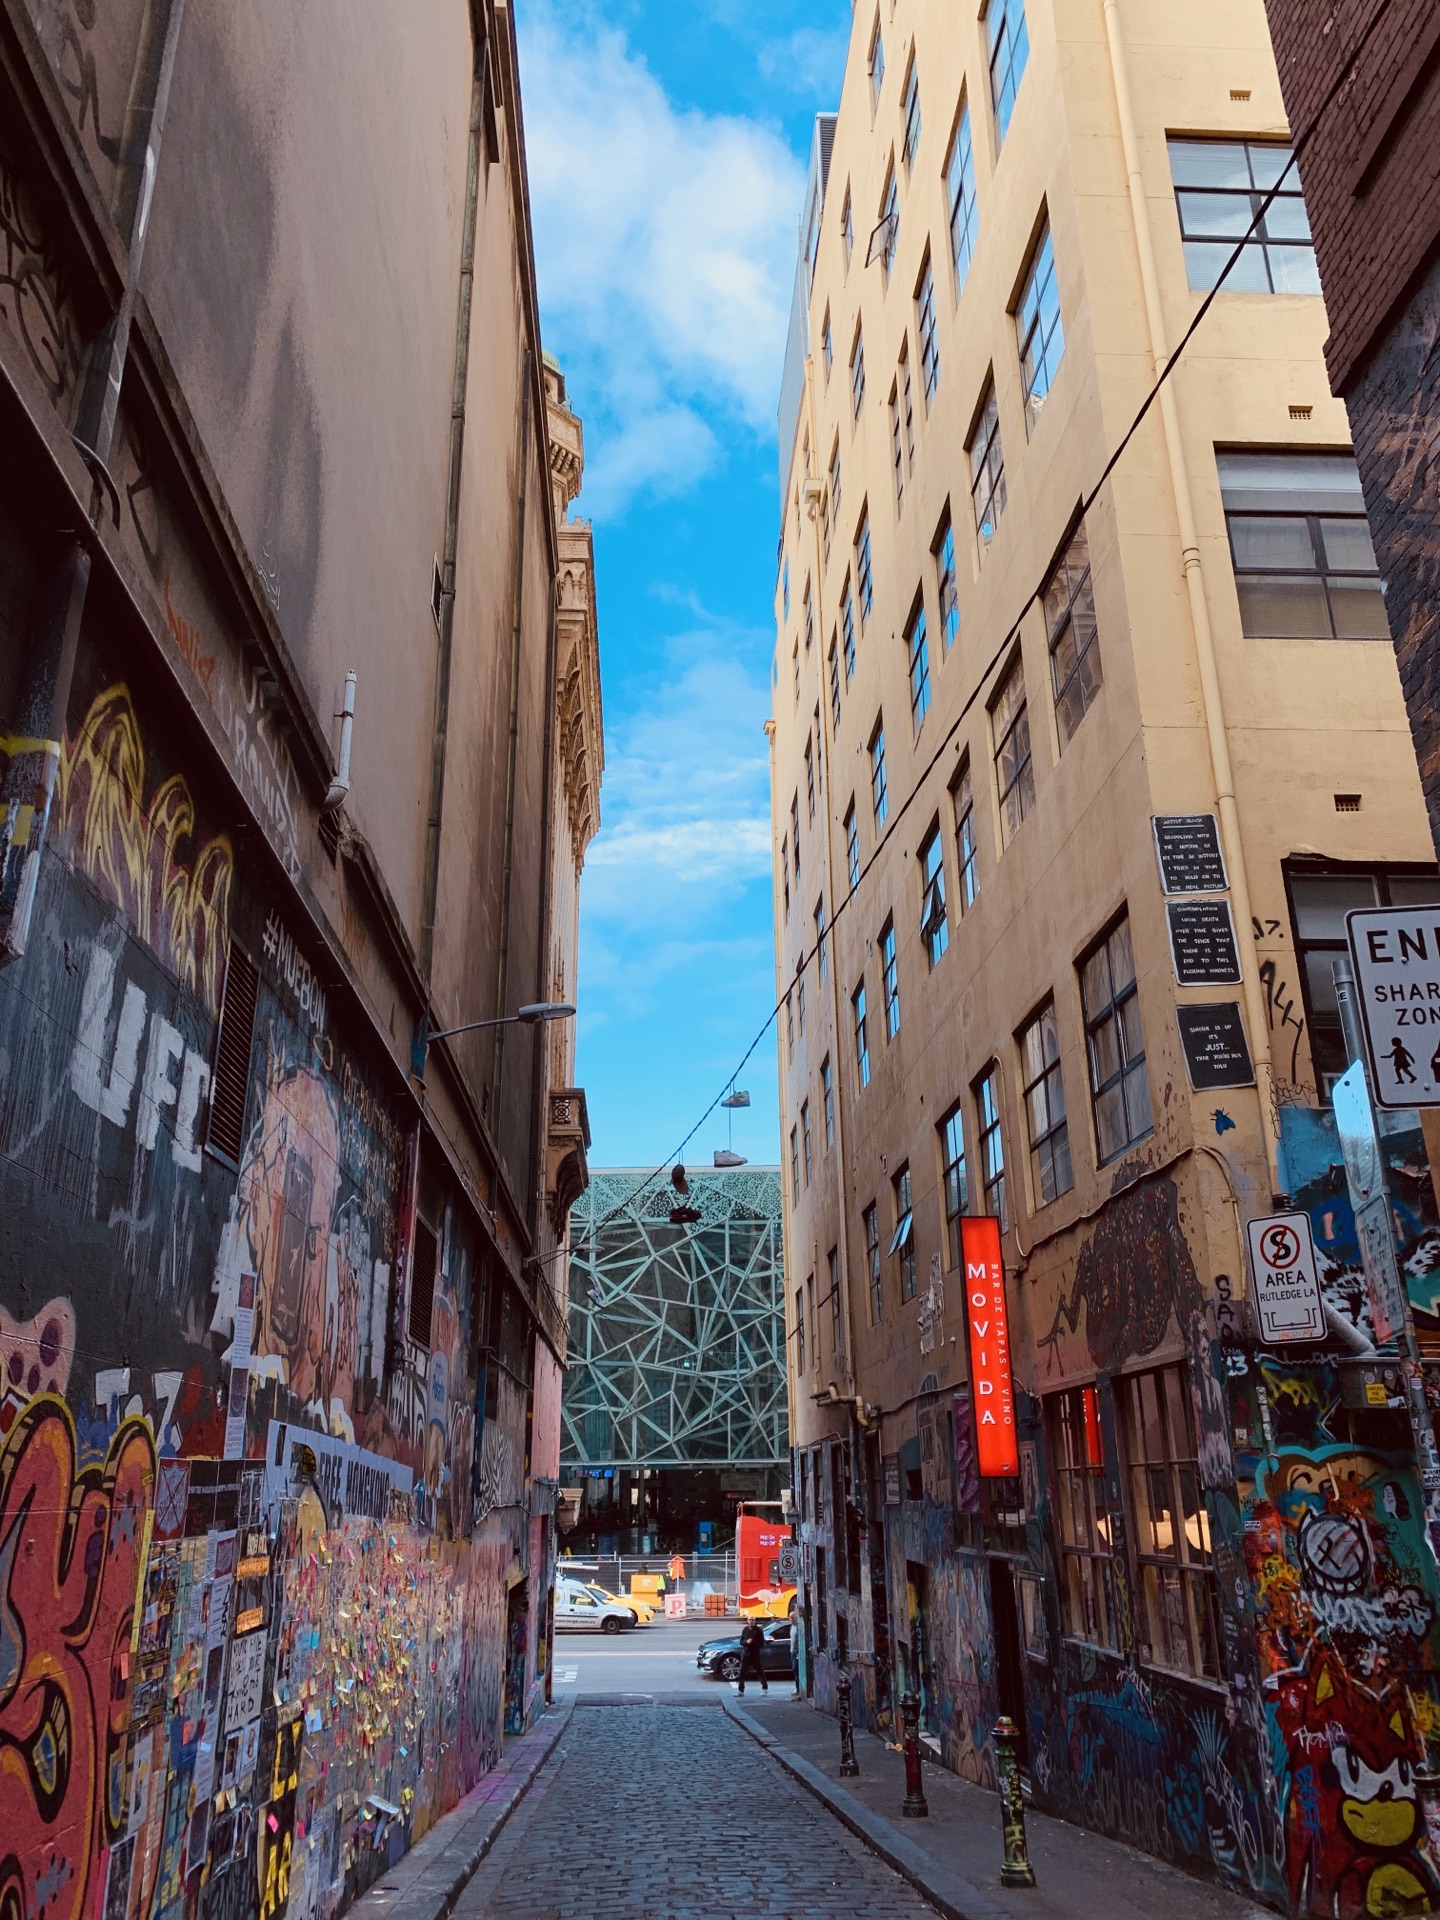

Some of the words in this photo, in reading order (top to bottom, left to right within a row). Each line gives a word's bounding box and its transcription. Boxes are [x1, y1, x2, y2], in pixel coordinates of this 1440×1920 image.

[991, 1263, 1000, 1288] BAR
[1265, 1270, 1307, 1288] AREA
[994, 1297, 1002, 1313] DE
[1260, 1288, 1301, 1303] RUTLEDGE
[1304, 1287, 1316, 1297] LA
[967, 1263, 996, 1425] MOVIDA
[996, 1321, 1007, 1364] TAPAS
[1002, 1388, 1012, 1425] VINO
[672, 1600, 682, 1614] P
[227, 1696, 255, 1724] HARD
